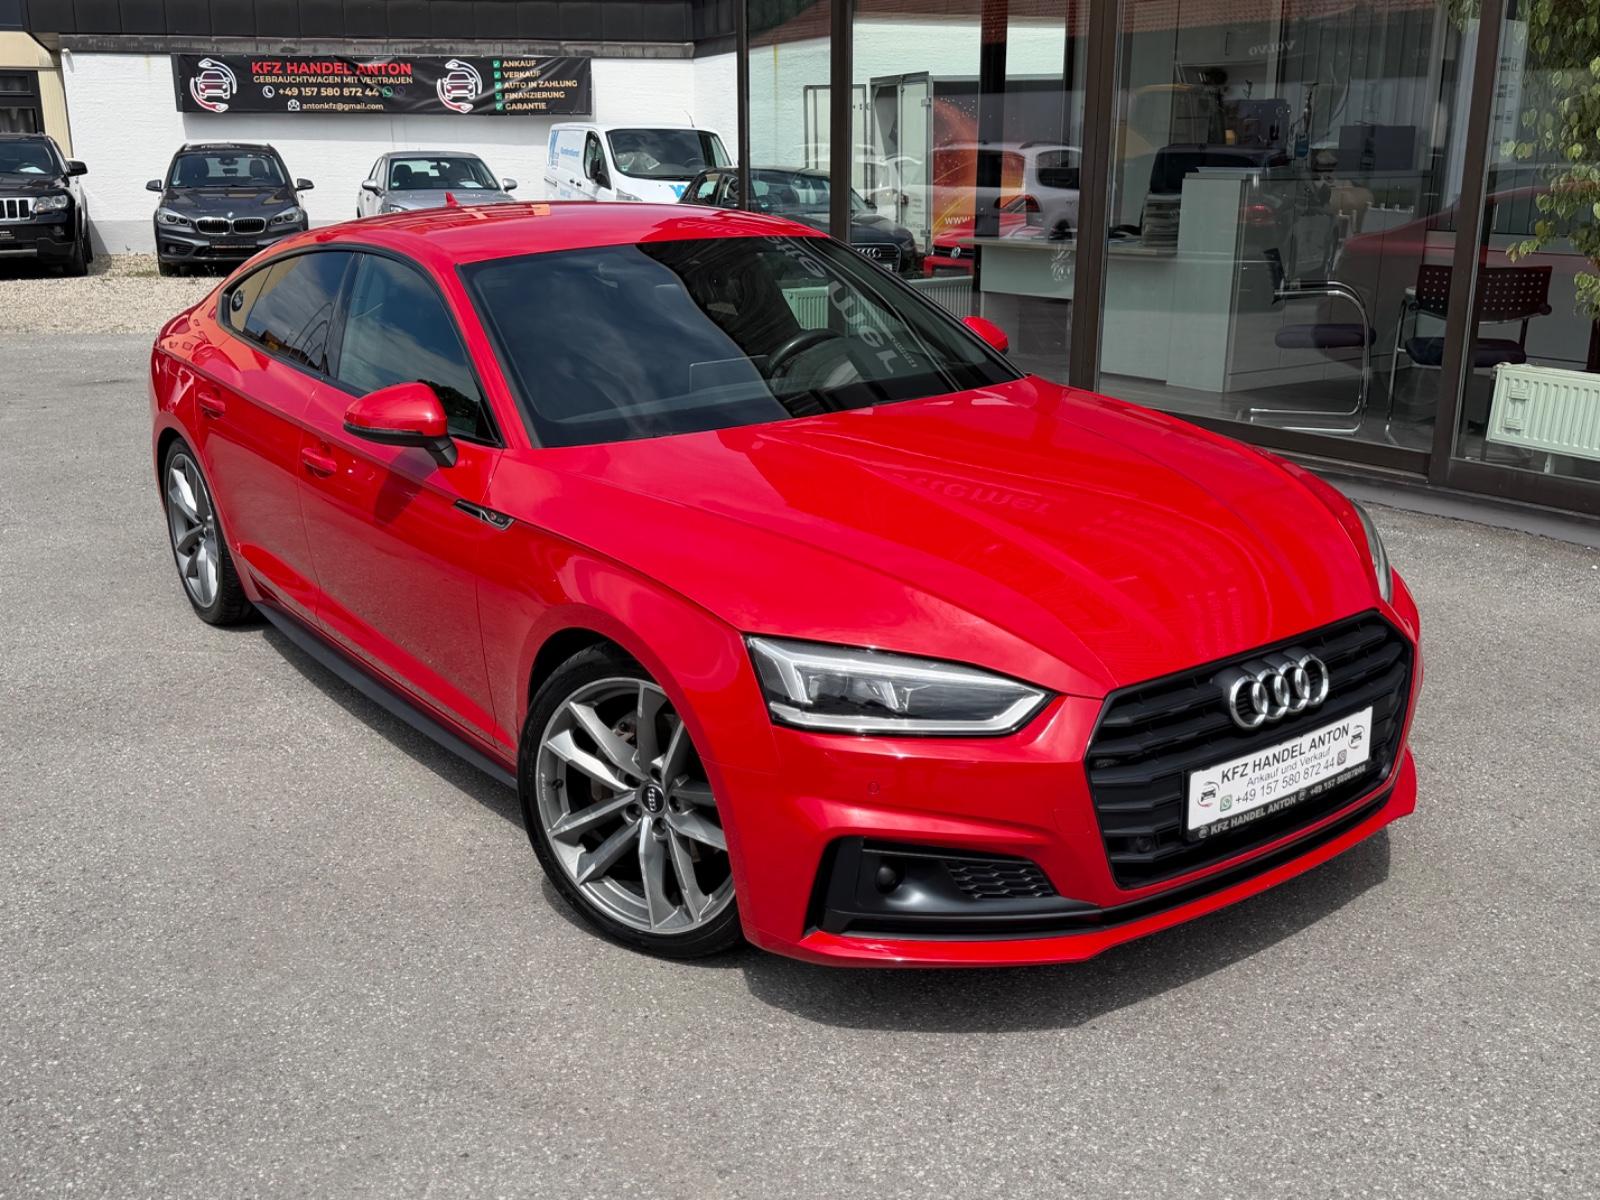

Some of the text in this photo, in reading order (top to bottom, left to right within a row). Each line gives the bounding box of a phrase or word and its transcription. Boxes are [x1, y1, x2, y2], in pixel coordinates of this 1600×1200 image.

[252, 62, 412, 75] KFZ HANDEL ANTON
[502, 60, 536, 68] ANKAUF
[503, 70, 541, 78] VERKAUF
[253, 75, 413, 84] GEBRAUCHTWAGEN MIT VERTRAUEN
[539, 80, 578, 88] ZAHLUNG
[279, 87, 380, 97] +49 157 580 872 44
[504, 91, 566, 100] FINANZIERUNG
[302, 102, 384, 111] antonkfz@gmail.com
[505, 102, 547, 110] GARANTIE
[1221, 722, 1350, 784] KFZ HANDEL ANTON
[1246, 745, 1331, 787] Ankauf und Verkauf
[1235, 757, 1335, 804] +49 157 580 872 44
[1210, 794, 1297, 835] KFZ HANDEL ANTON
